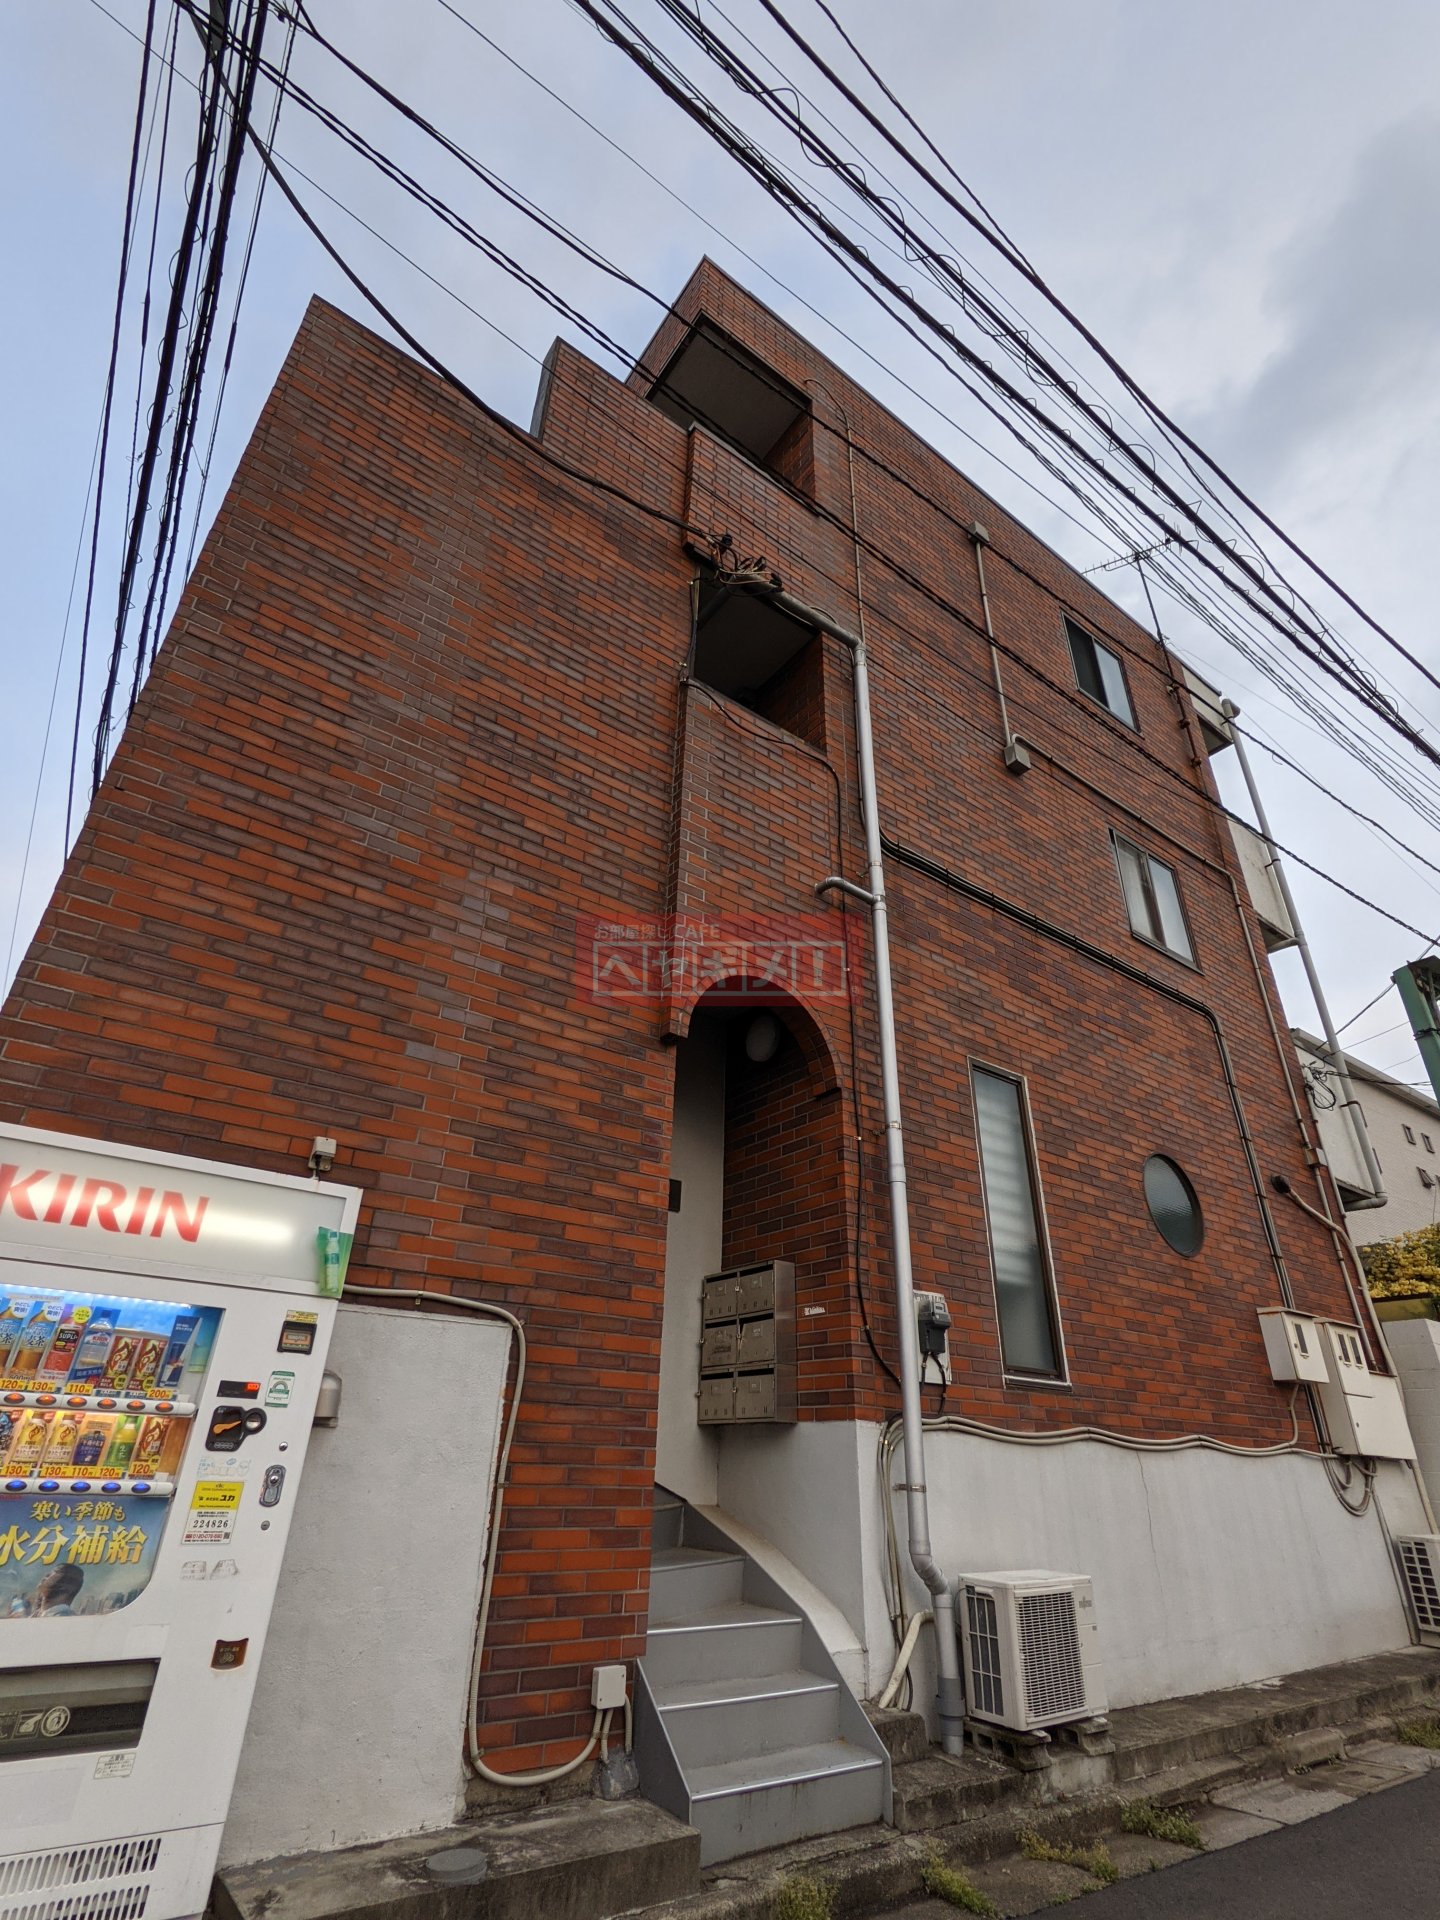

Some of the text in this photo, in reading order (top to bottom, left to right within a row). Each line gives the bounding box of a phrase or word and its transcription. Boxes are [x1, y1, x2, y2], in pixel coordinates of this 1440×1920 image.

[0, 1163, 210, 1244] KIRIN
[30, 1500, 126, 1522] 寒い季節も
[193, 1519, 229, 1528] 224826
[0, 1524, 148, 1568] 水分補給
